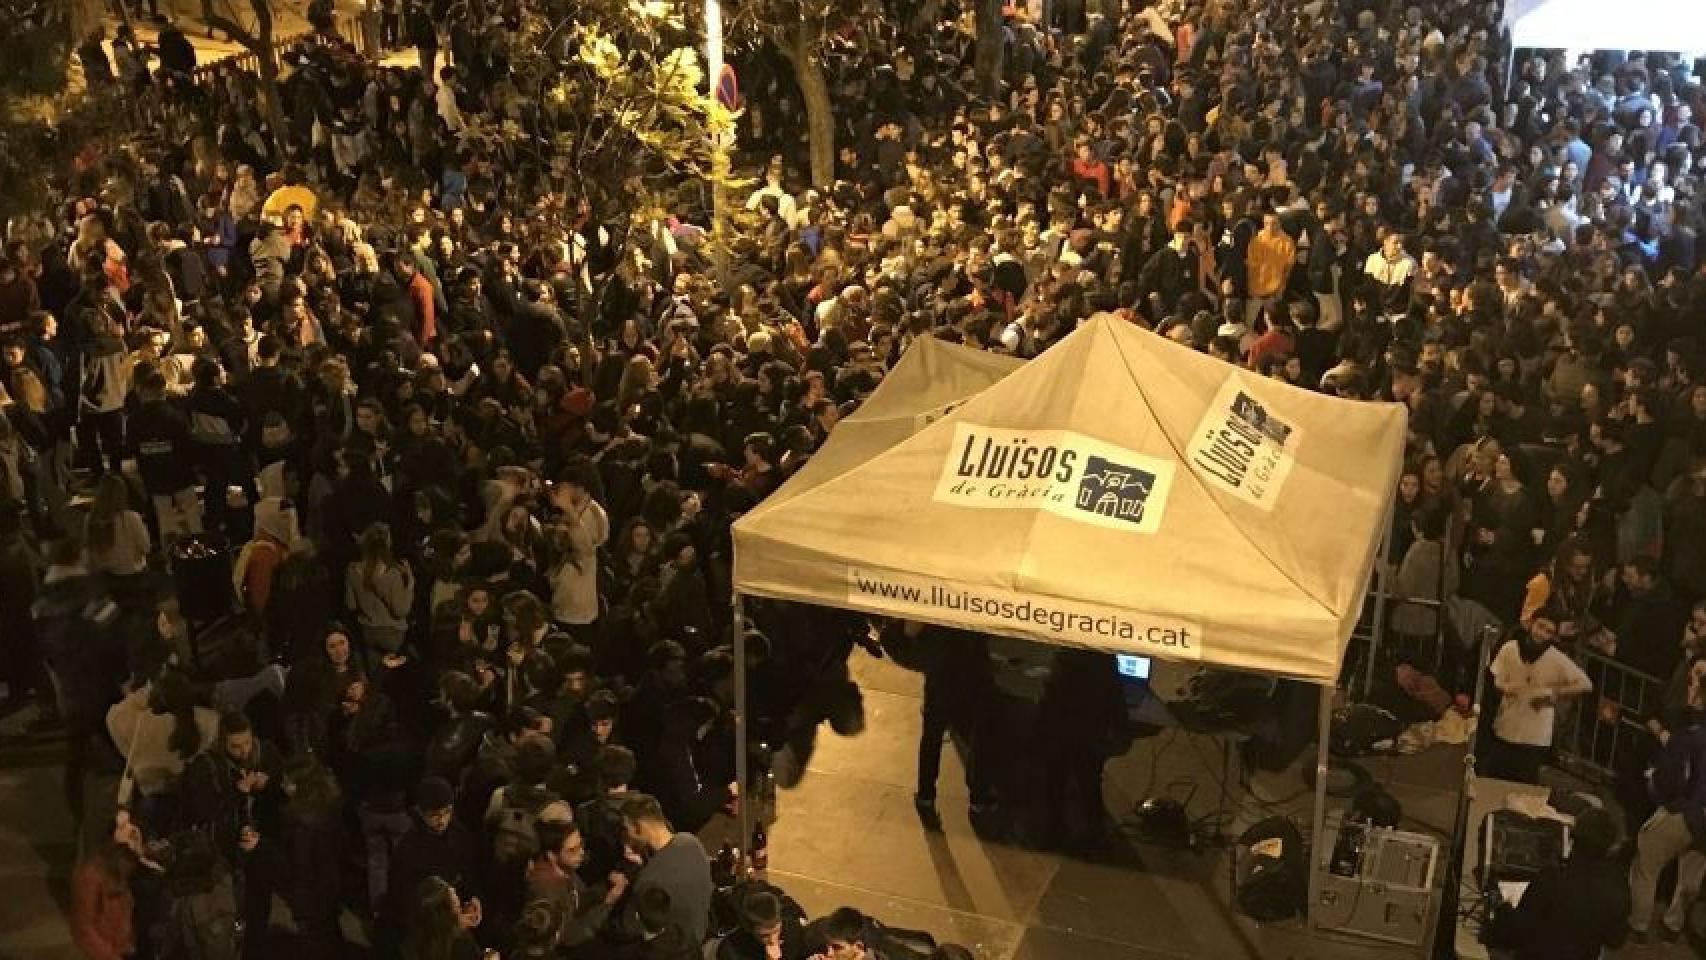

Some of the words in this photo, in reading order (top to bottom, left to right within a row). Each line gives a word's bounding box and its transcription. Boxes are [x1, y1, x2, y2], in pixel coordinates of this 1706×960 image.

[957, 433, 1077, 483] Lluïsos
[949, 480, 977, 497] de
[987, 483, 1065, 502] Gràcia
[857, 577, 1192, 650] www.lluisosdegracia.cat
